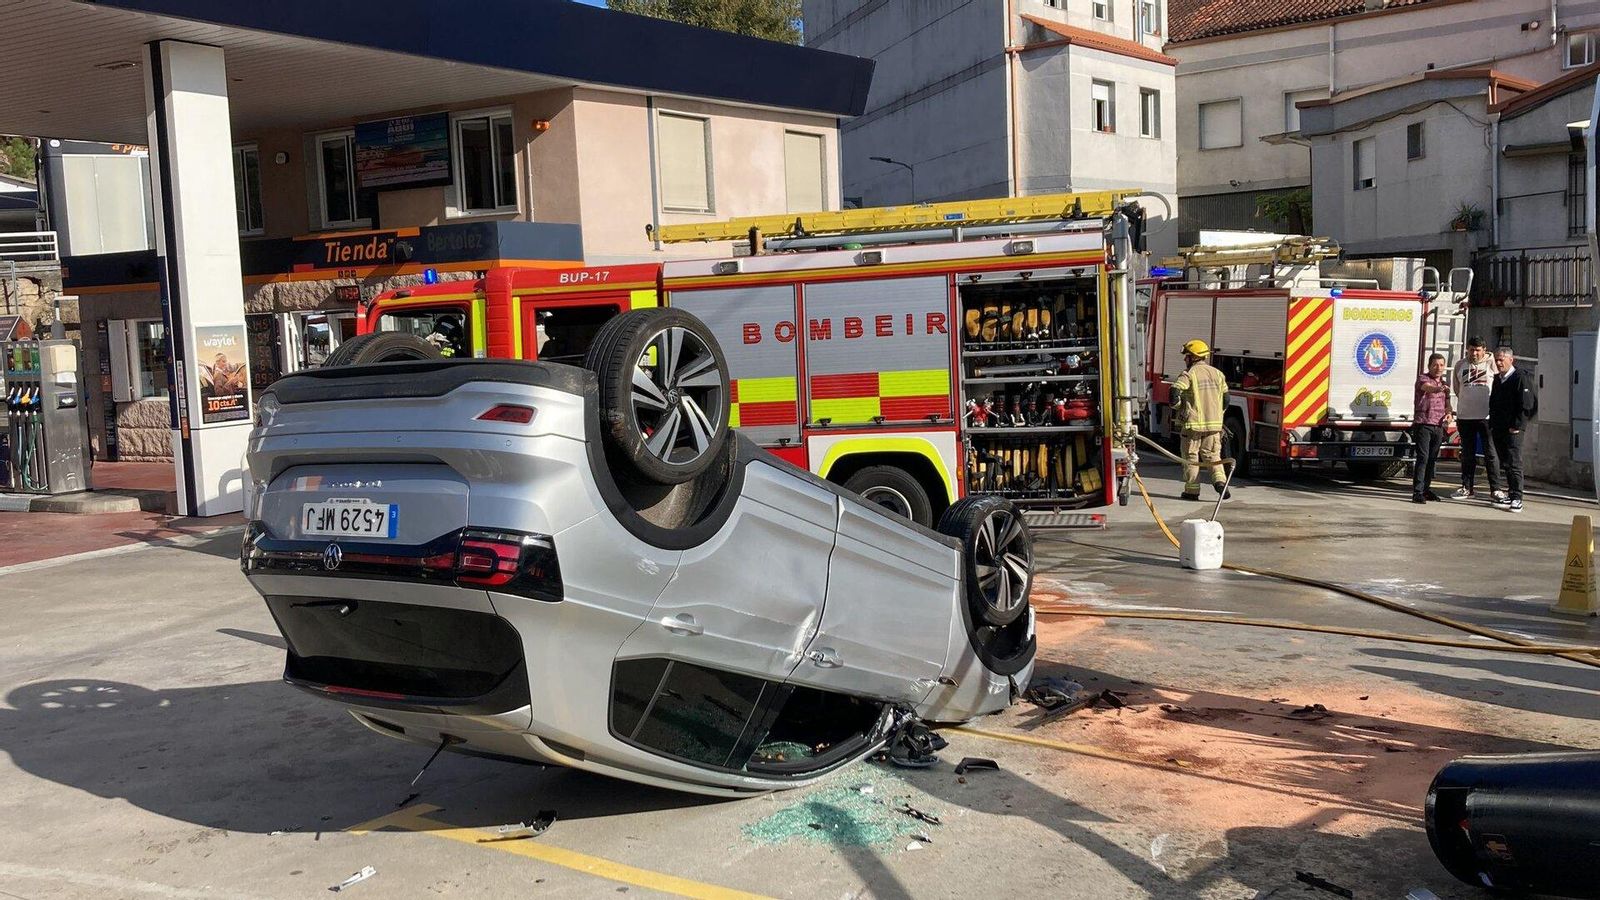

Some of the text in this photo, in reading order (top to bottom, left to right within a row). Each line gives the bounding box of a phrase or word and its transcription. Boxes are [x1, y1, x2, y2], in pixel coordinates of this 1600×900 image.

[559, 271, 610, 284] BUP-17
[1342, 307, 1414, 321] BOMBEIROS
[208, 400, 220, 411] 10
[306, 508, 336, 531] MFJ
[340, 508, 385, 533] 4529
